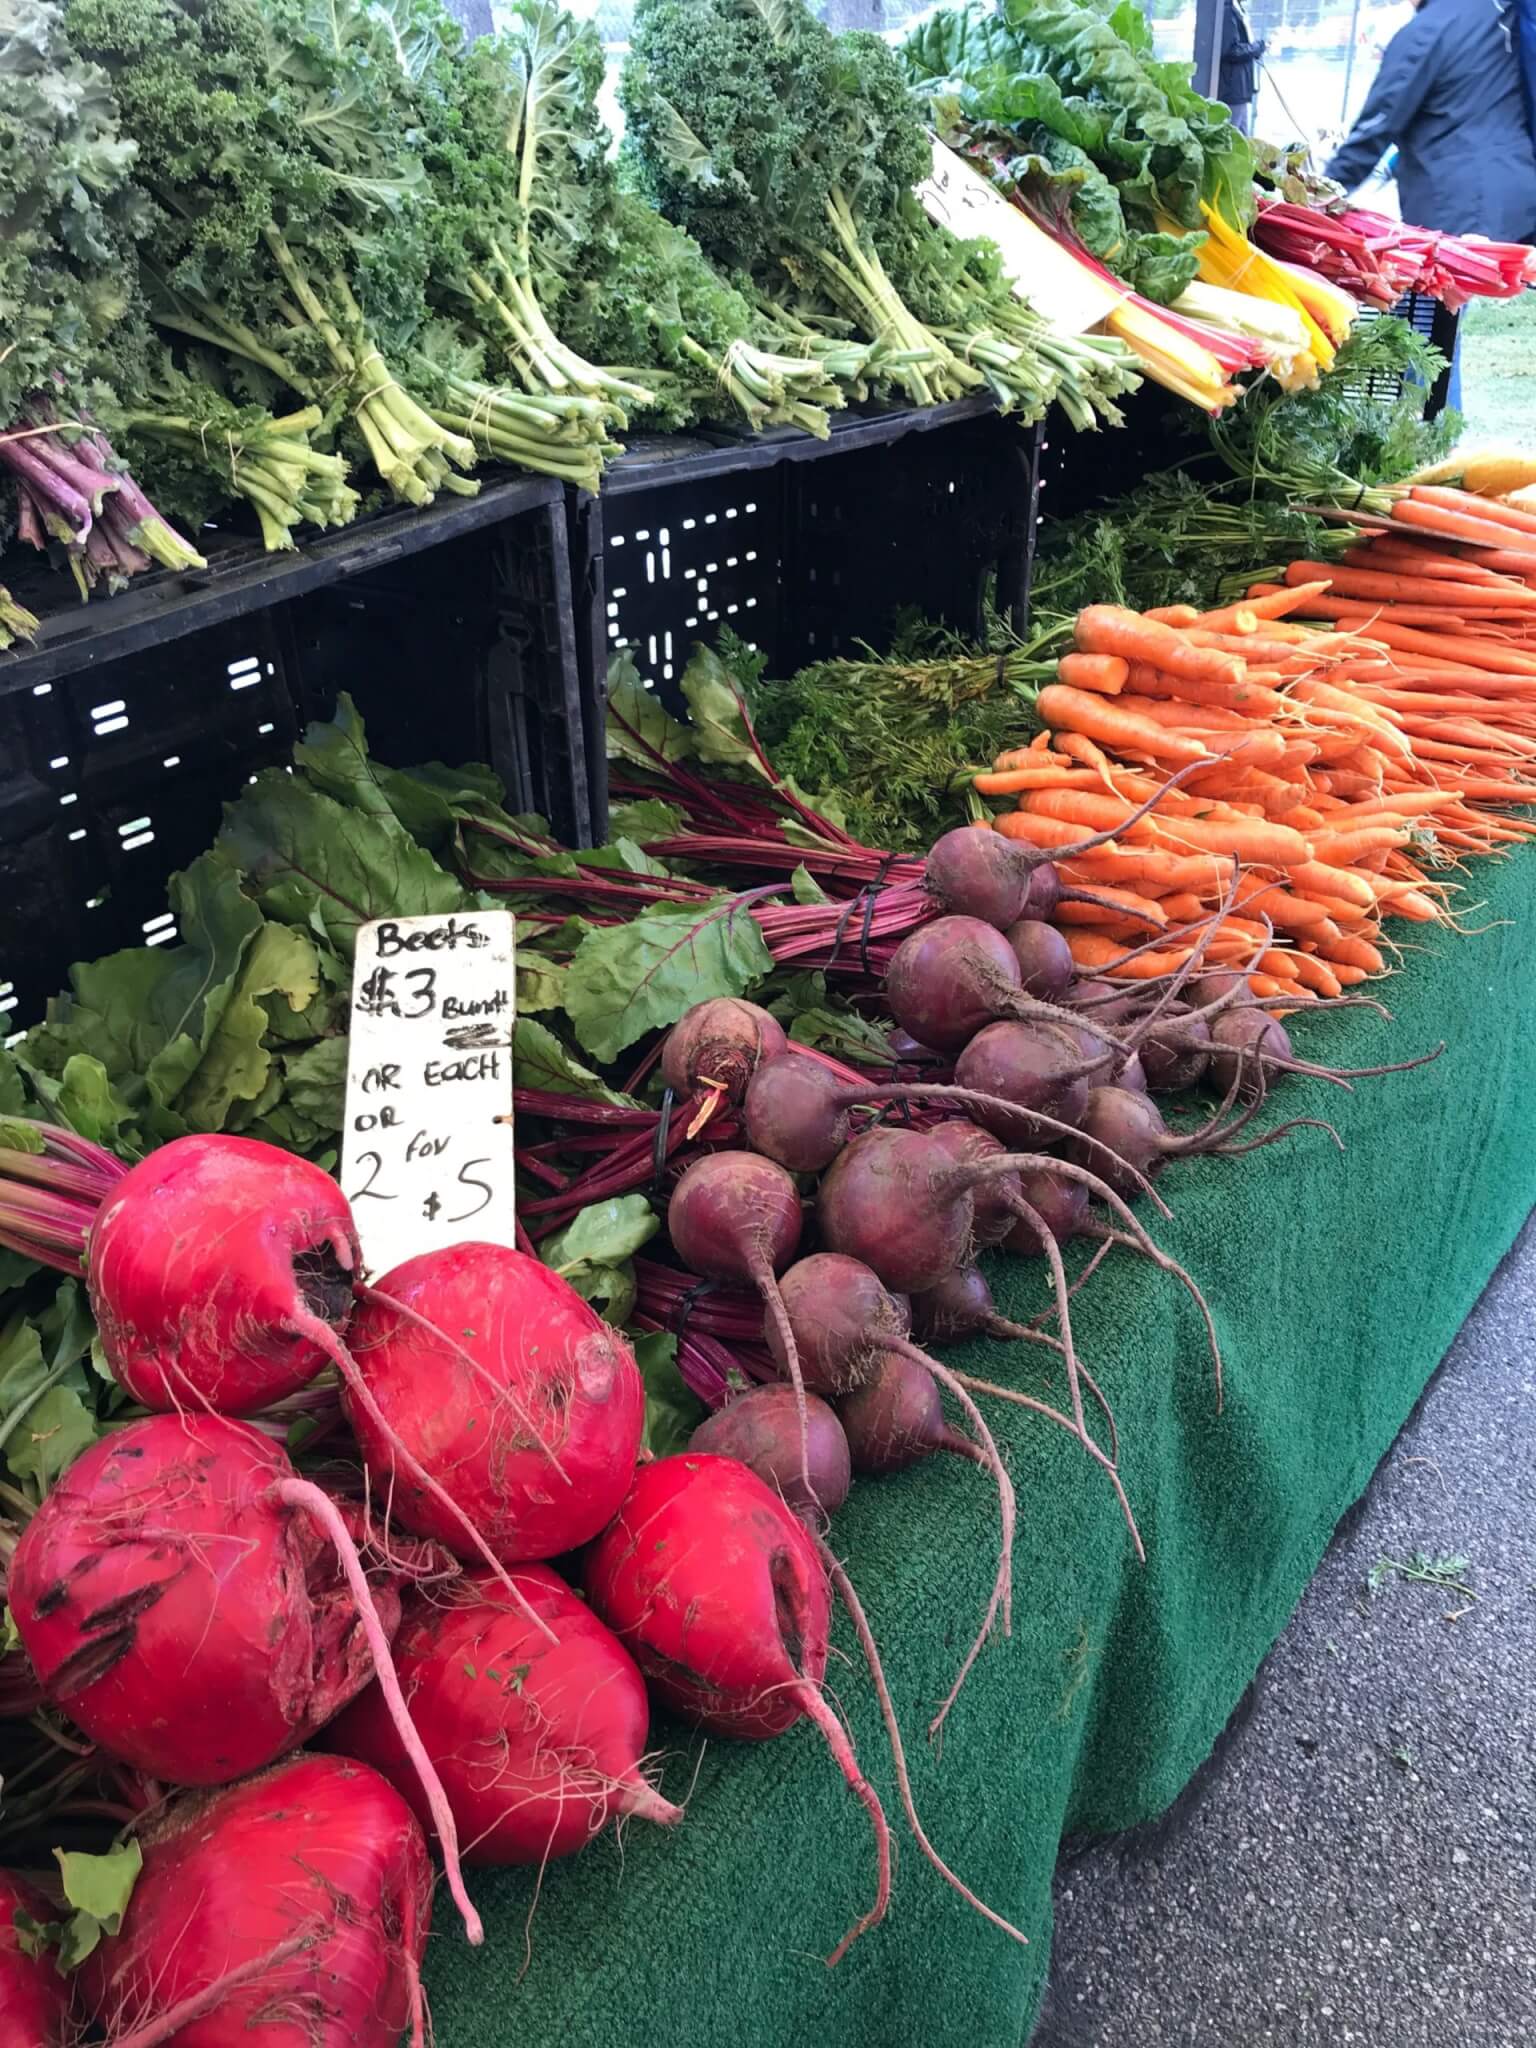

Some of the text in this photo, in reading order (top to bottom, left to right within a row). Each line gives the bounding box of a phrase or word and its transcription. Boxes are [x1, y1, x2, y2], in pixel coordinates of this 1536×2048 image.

[376, 919, 491, 957] Beets
[355, 965, 436, 1018] $3
[354, 1106, 402, 1132] OR
[349, 1151, 398, 1201] 2
[406, 1130, 450, 1162] for
